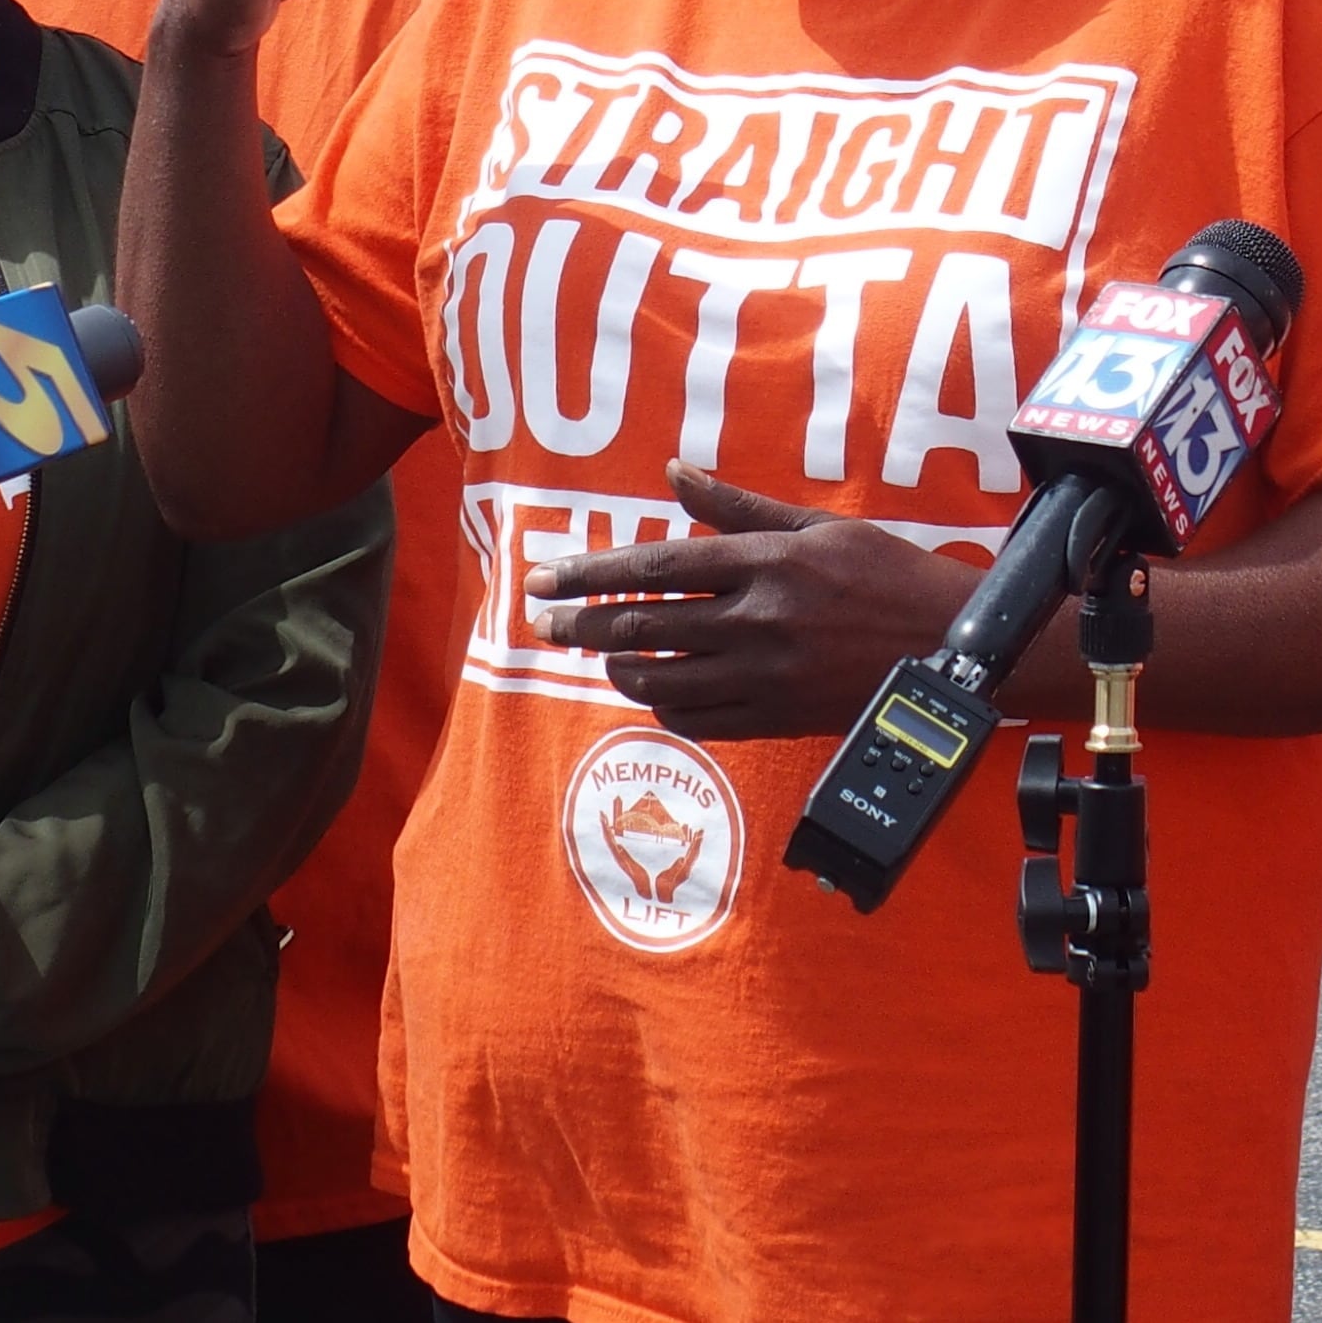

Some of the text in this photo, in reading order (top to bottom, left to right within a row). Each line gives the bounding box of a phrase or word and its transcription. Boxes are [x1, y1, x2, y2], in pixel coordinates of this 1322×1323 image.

[491, 71, 1092, 225] STRAIGHT
[1100, 290, 1207, 336] FOX
[450, 218, 1021, 494] OUTTA
[1049, 334, 1180, 410] 13
[1213, 327, 1272, 434] FOX
[1023, 408, 1132, 436] NEWS
[1162, 374, 1241, 497] 13
[1141, 437, 1190, 536] NEWS
[591, 761, 717, 810] MEMPHIS
[839, 788, 898, 828] SONY
[622, 896, 692, 930] LIFT
